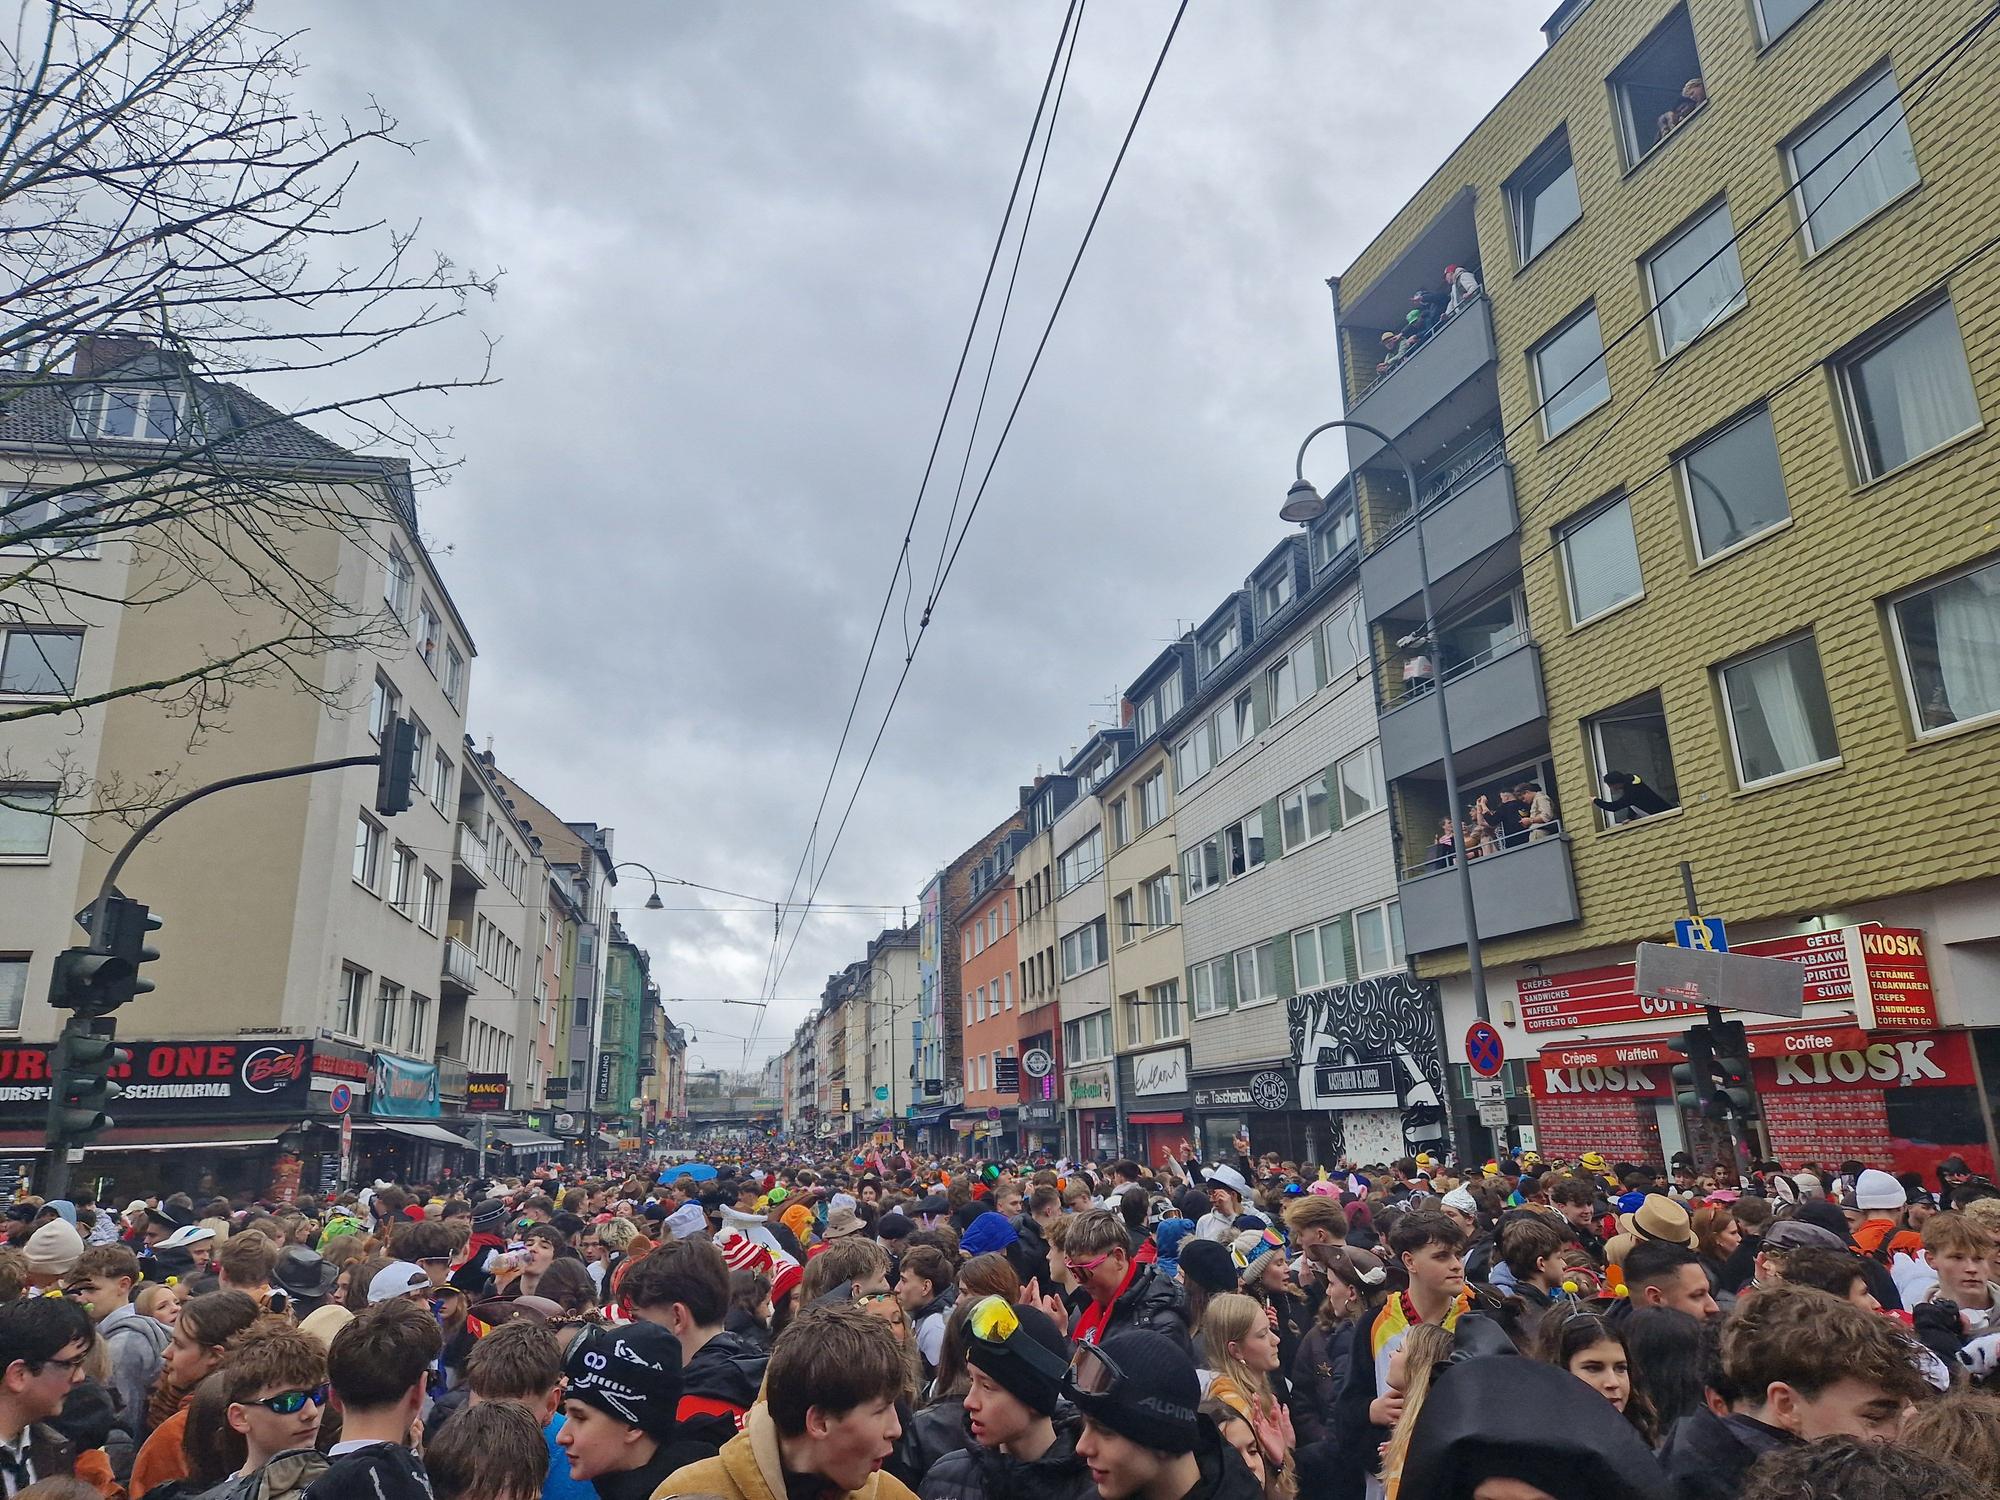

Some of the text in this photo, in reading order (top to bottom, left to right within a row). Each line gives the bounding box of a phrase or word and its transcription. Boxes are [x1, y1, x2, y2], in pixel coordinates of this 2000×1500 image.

[1862, 934, 1923, 956] KIOSK
[1870, 971, 1915, 979] GETRÄNKE
[1871, 981, 1930, 990] TABAKWAREN
[1524, 990, 1570, 1003] SANDWICHES
[1526, 1005, 1559, 1016] WAFFELN
[1875, 1005, 1926, 1014] SANDWICHES
[1528, 1016, 1578, 1028] COFFEE TO GO
[1877, 1017, 1907, 1025] COFFEE
[1908, 1017, 1919, 1025] TO
[1785, 1034, 1833, 1051] Coffee
[148, 1046, 237, 1078] ONE
[1562, 1047, 1658, 1067] Crêpes Waffeln
[1775, 1040, 1947, 1086] KIOSK
[1543, 1065, 1656, 1094] KIOSK
[469, 1083, 505, 1093] MANGO
[1210, 1089, 1253, 1104] Taschenbu
